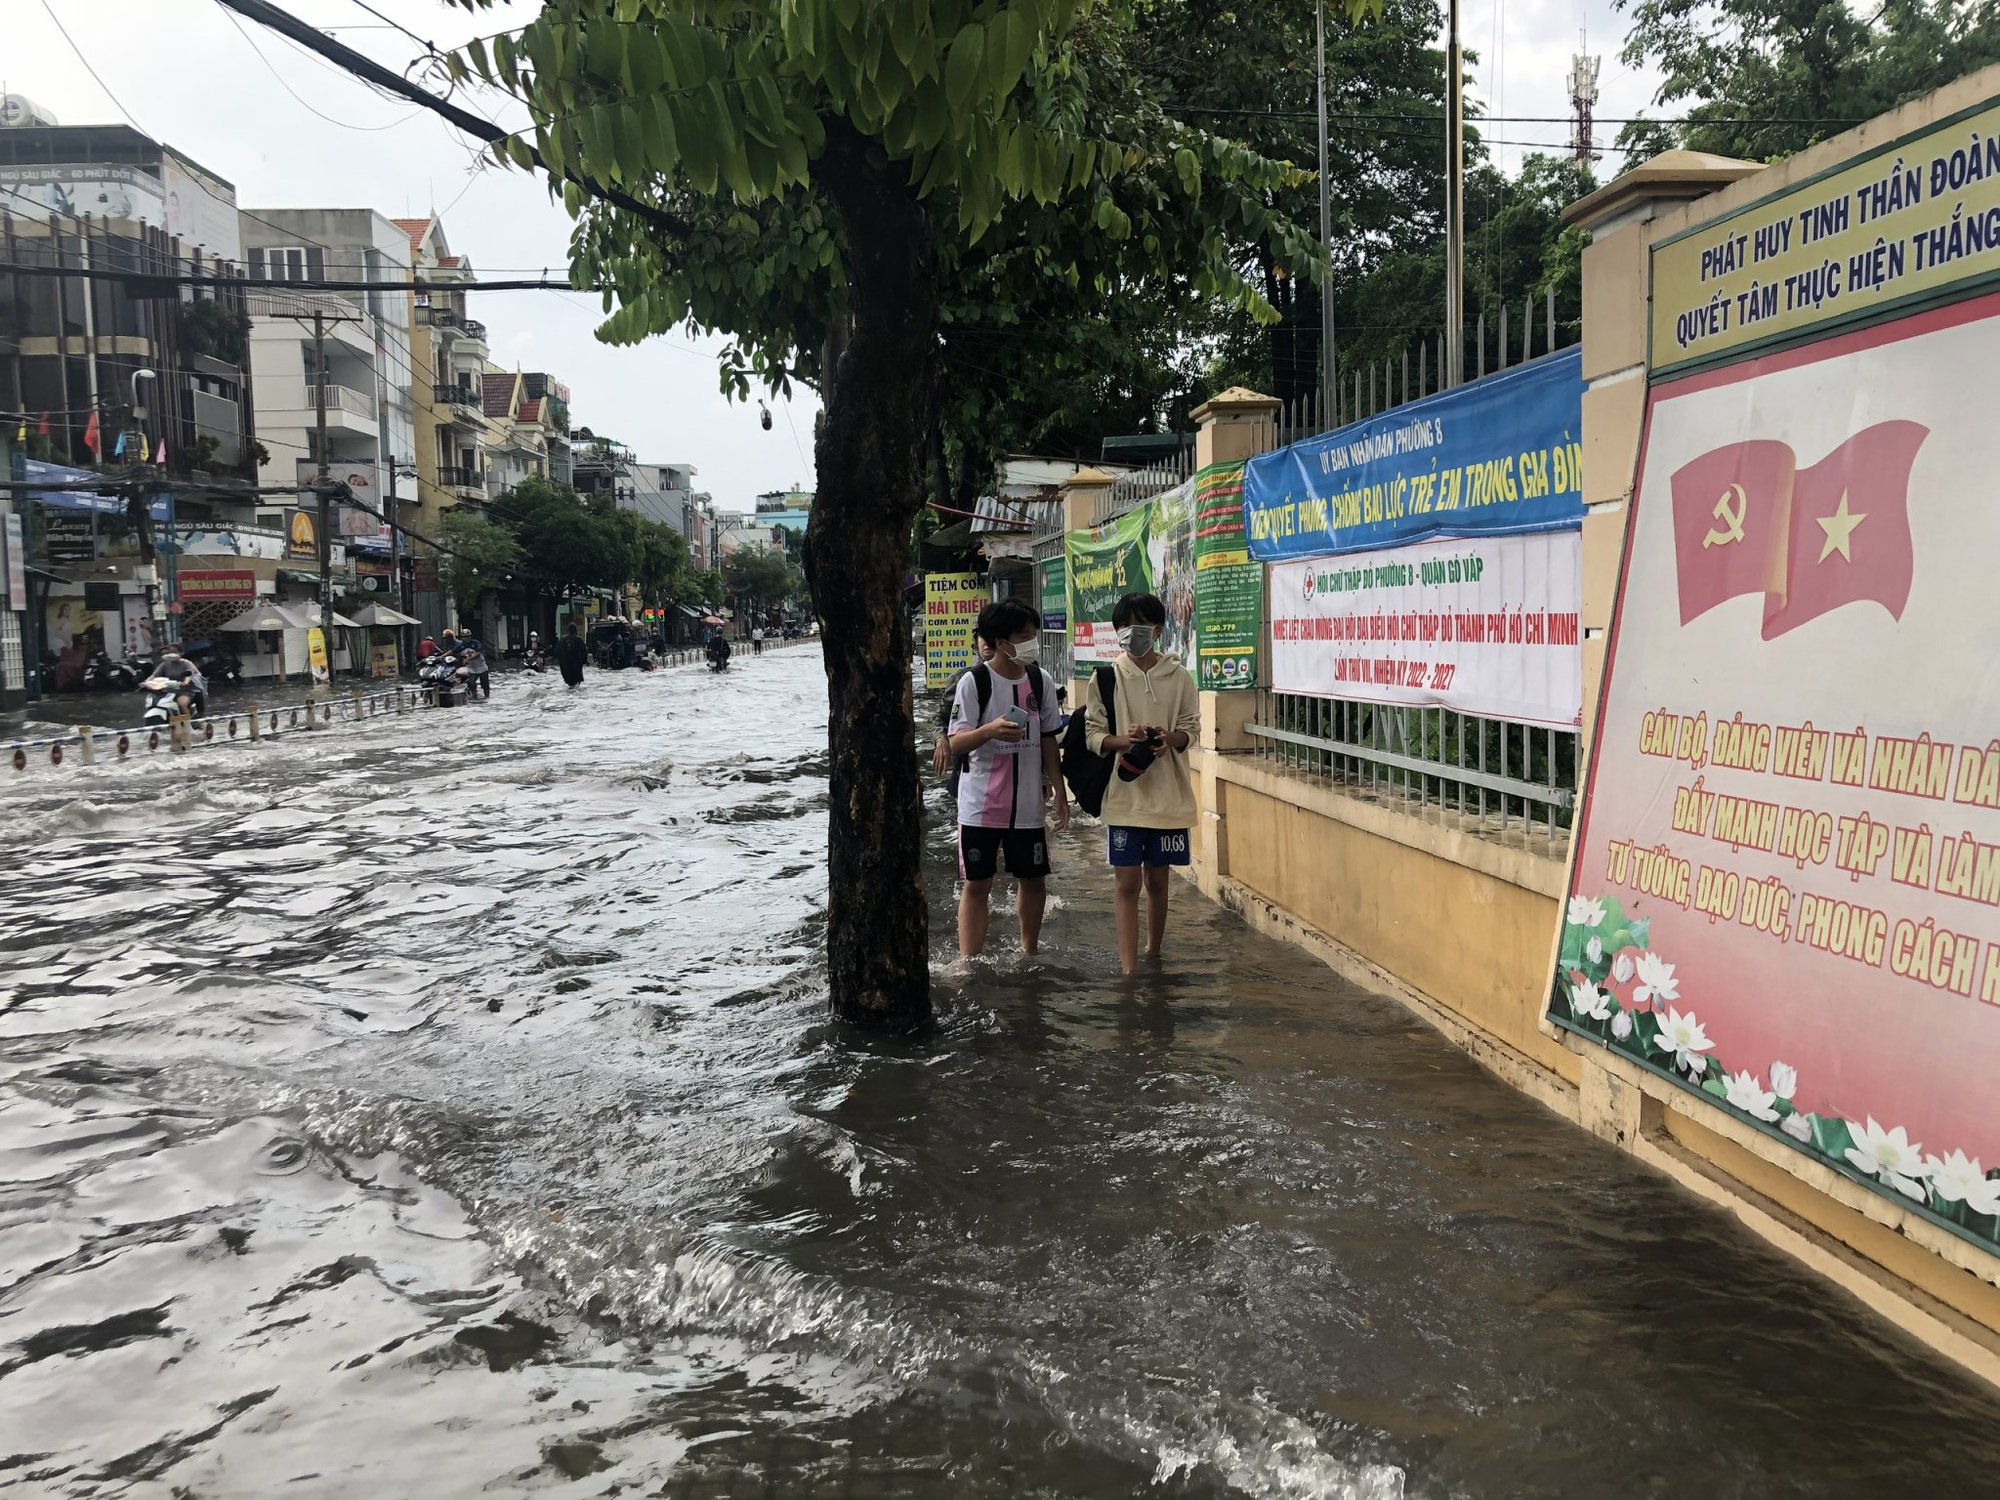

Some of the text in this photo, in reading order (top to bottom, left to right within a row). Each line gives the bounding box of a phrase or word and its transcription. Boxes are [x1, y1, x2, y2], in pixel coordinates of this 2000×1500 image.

[1701, 232, 1748, 282] PHÁT
[1754, 217, 1794, 262] HUY
[1800, 195, 1850, 244] TINH
[1857, 157, 1922, 224] THẦN
[1677, 202, 2000, 348] QUYẾT TÂM THỰC HIỆN THẮNG
[1331, 449, 1350, 473] BAN
[1350, 433, 1374, 467] NHÂN
[1375, 427, 1393, 459] DÂN
[1395, 417, 1434, 455] PHƯỜNG
[1435, 418, 1443, 445] 8
[1332, 478, 1362, 530] CHỐNG
[1364, 483, 1383, 531] BẠO
[1385, 472, 1407, 528] LỰC
[1408, 456, 1437, 516] TRẺ
[1435, 467, 1461, 512] EM
[1465, 456, 1518, 508] TRONG
[1519, 449, 1549, 500] GIA
[929, 576, 986, 594] TIỆM CƠM
[1317, 570, 1329, 597] HỘI
[1330, 569, 1343, 592] CHỮ
[1344, 566, 1362, 595] THẬP
[1363, 561, 1374, 589] ĐỎ
[1375, 560, 1406, 588] PHƯỜNG
[1408, 565, 1414, 586] 8
[1421, 556, 1446, 590] QUẬN
[1448, 553, 1461, 584] GÒ
[1462, 549, 1484, 583] VẤP
[928, 596, 948, 615] HẢI
[928, 618, 948, 626] CƠM
[1314, 613, 1332, 641] MỪNG
[1334, 616, 1344, 646] ĐẠI
[1345, 612, 1356, 646] HỘI
[1357, 616, 1369, 646] ĐẠI
[1370, 605, 1386, 641] BIỂU
[1387, 610, 1400, 646] HỘI
[1401, 610, 1417, 641] CHỮ
[1418, 609, 1439, 648] THẬP
[1441, 604, 1453, 642] ĐỎ
[1454, 607, 1485, 643] THÀNH
[1487, 602, 1508, 644] PHỐ
[1508, 602, 1523, 644] HỒ
[1525, 606, 1545, 645] CHÍ
[1548, 612, 1579, 646] MINH
[1348, 653, 1362, 683] THỨ
[1374, 654, 1396, 691] NHIỆM
[1396, 654, 1408, 687] KỲ
[1406, 662, 1428, 688] 2022
[1430, 663, 1456, 691] 2027
[1639, 707, 1679, 758] CÁN
[1677, 710, 1708, 771] BỘ,
[1711, 711, 1772, 774] ĐẢNG
[1773, 720, 1830, 782] VIÊN
[1830, 726, 1868, 788] VÀ
[1868, 732, 1954, 801] NHÂN
[1672, 775, 2000, 907] ĐẨY MẠNH HỌC TẬP VÀ LÀM
[1606, 839, 1634, 886] TƯ
[1630, 843, 1692, 911] TƯỞNG,
[1694, 864, 1740, 925] ĐẠO
[1739, 875, 1792, 944] ĐỨC,
[1796, 892, 1888, 968] PHONG
[1890, 916, 1980, 998] CÁCH
